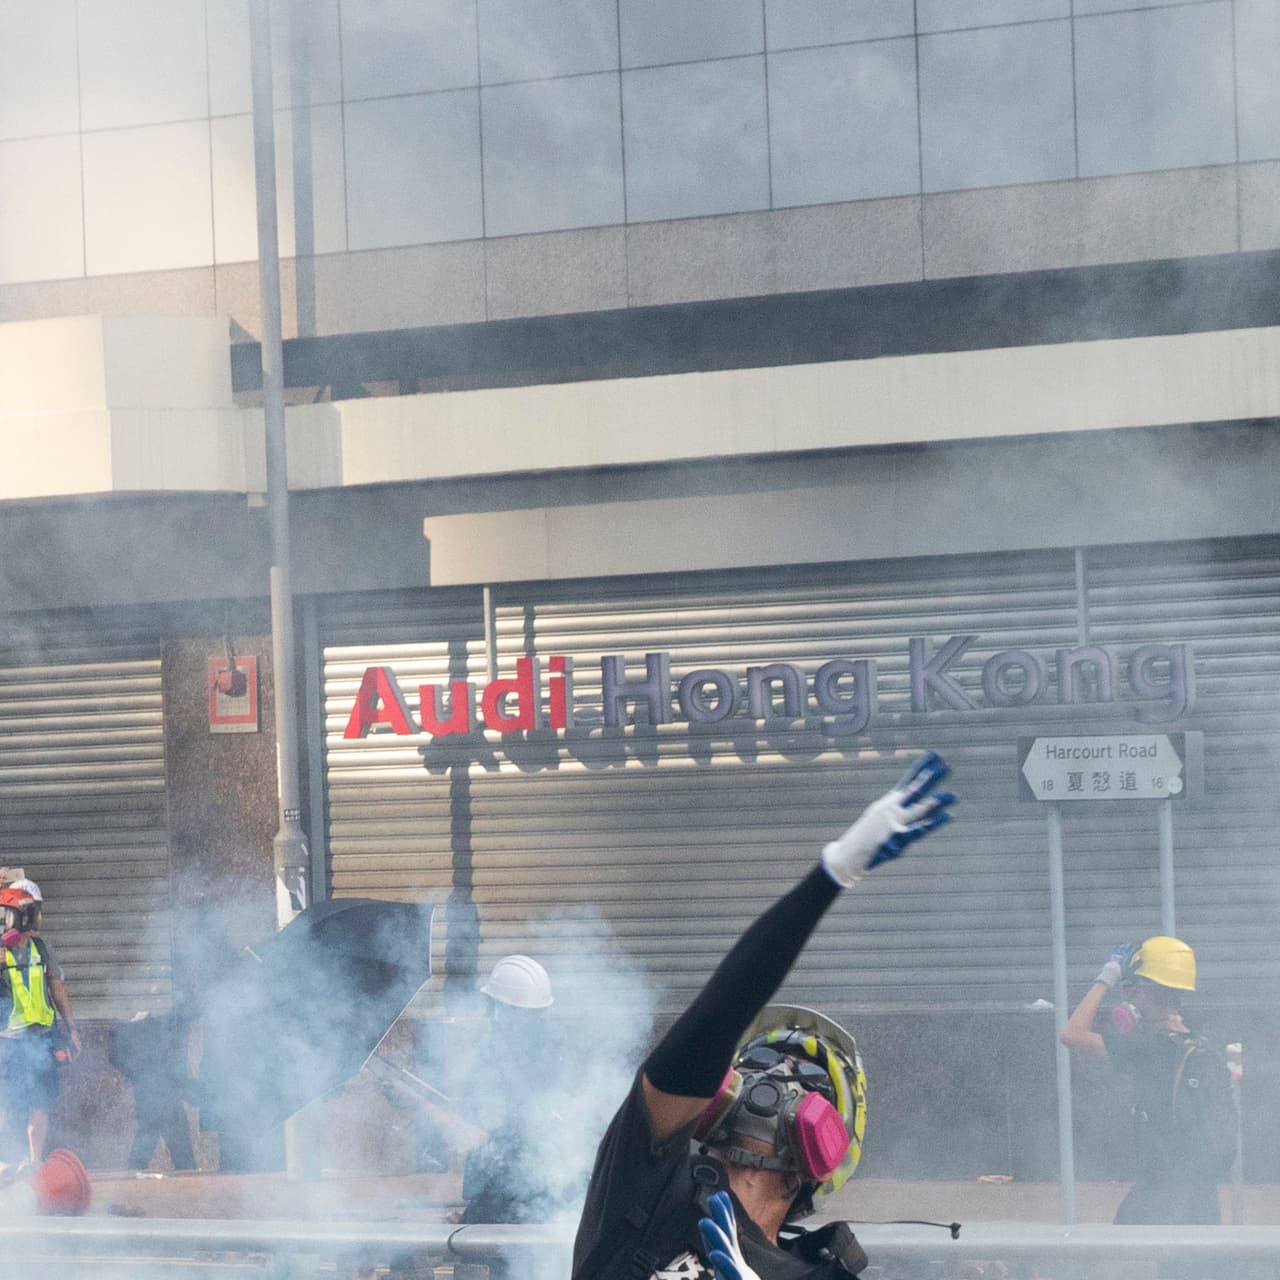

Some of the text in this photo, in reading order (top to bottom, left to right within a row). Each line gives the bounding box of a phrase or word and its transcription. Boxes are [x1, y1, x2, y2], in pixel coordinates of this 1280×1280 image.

[343, 634, 1195, 740] Audi Hong Kong
[1046, 743, 1157, 760] Harcourt Road
[1041, 779, 1054, 791] 18
[1152, 777, 1163, 789] 16
